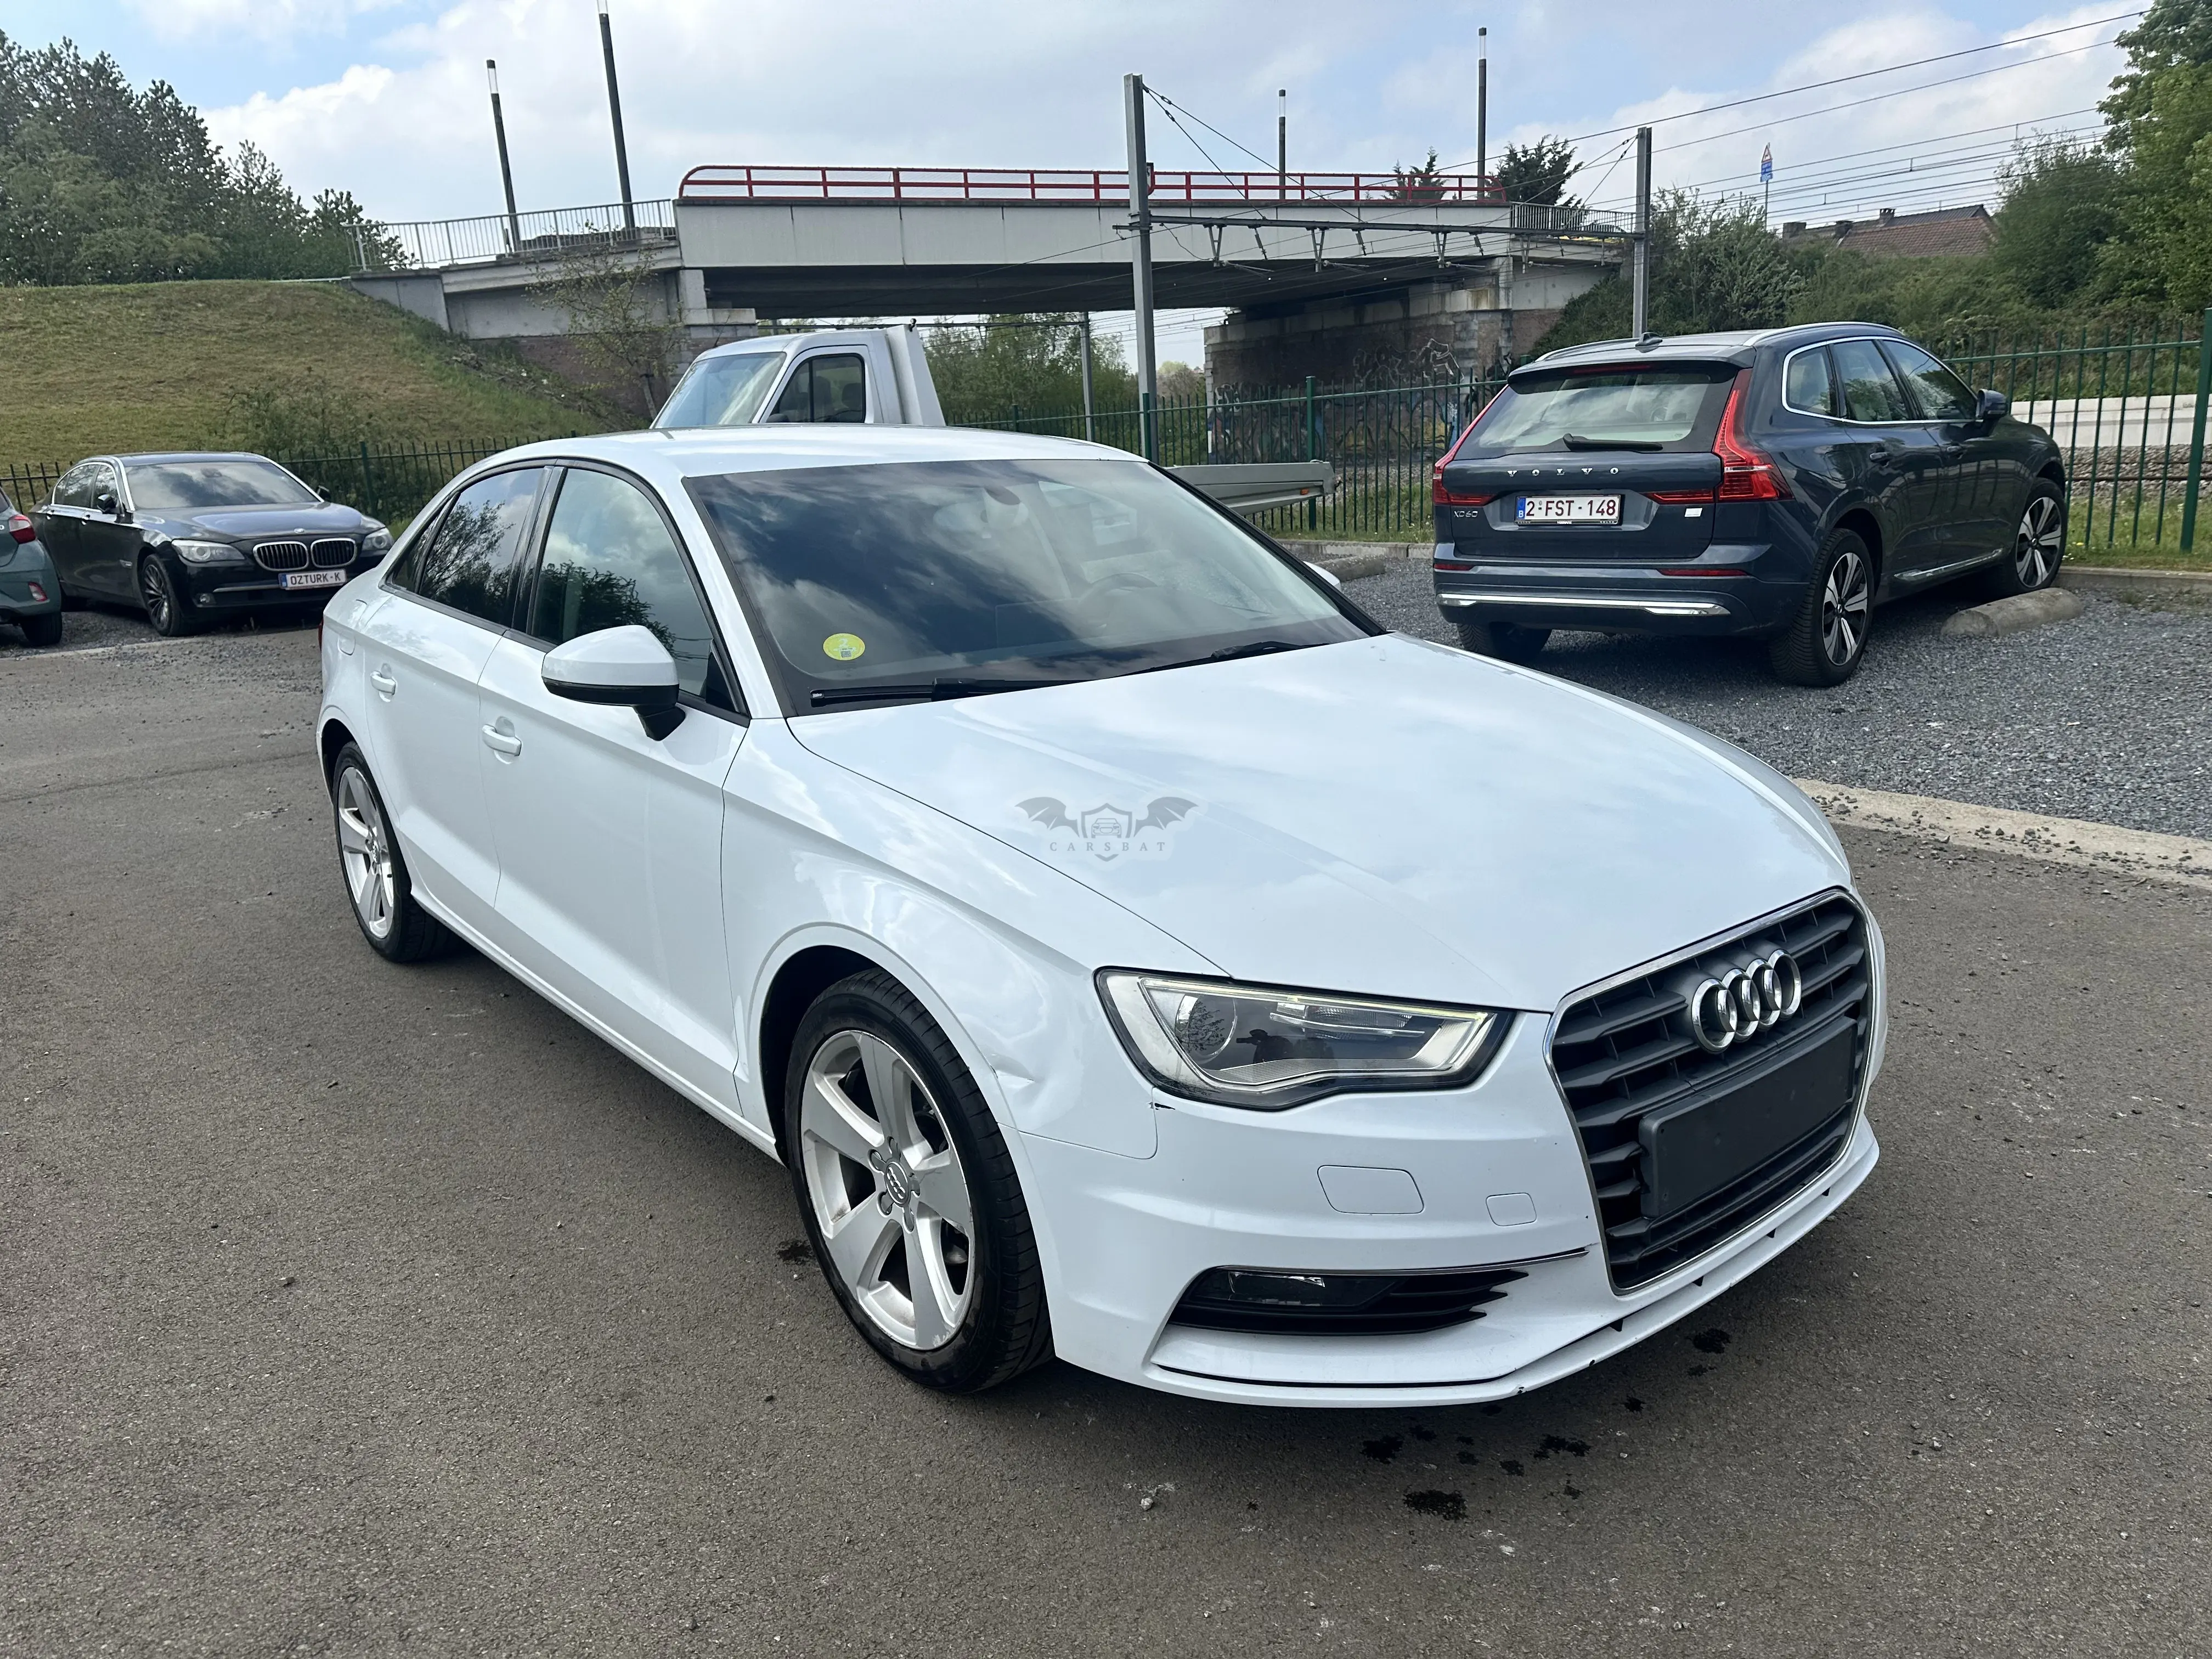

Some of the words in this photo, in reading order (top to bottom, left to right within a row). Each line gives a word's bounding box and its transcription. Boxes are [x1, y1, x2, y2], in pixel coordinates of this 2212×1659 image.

[1507, 467, 1619, 477] VOLVO
[1526, 499, 1616, 517] 2-FST-148
[1518, 510, 1524, 518] B
